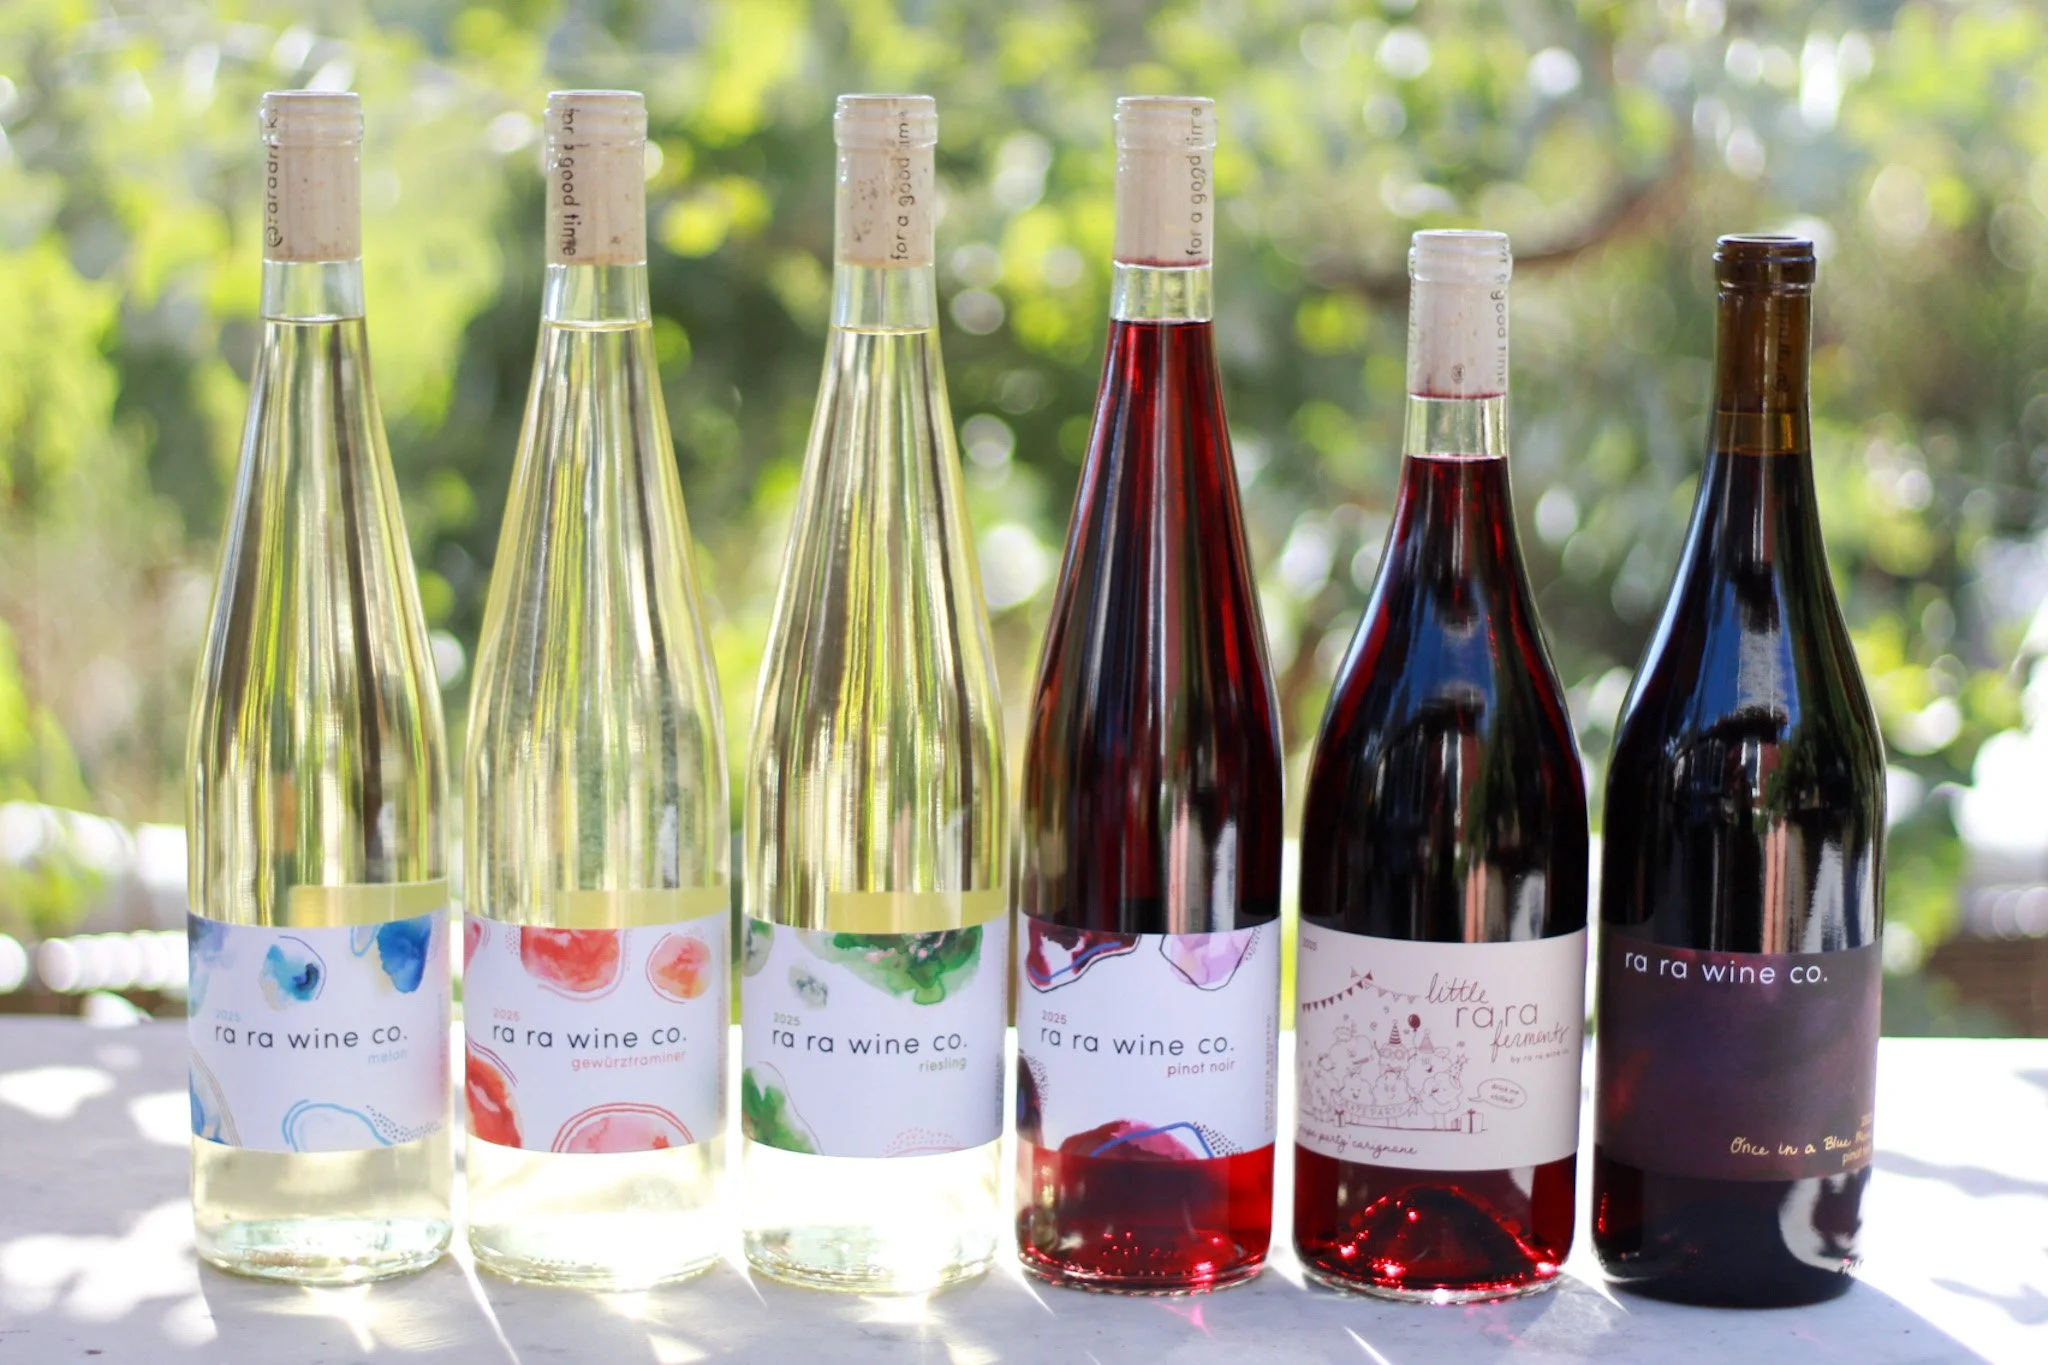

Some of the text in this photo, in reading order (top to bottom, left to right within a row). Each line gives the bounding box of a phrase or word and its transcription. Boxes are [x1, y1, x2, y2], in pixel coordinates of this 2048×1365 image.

[559, 157, 581, 206] good
[891, 157, 915, 207] good
[1186, 155, 1207, 205] good
[898, 215, 909, 227] a
[1191, 212, 1202, 223] a
[562, 213, 581, 256] time
[1185, 232, 1202, 256] for
[891, 234, 909, 260] for
[1625, 952, 1828, 984] ra ra wine co.
[1425, 973, 1489, 1004] little
[215, 1009, 241, 1022] 2025
[493, 1007, 521, 1021] 2025
[773, 1012, 801, 1026] 2025
[1041, 1010, 1067, 1025] 2025
[215, 1025, 408, 1049] ra ra wine co.
[493, 1025, 687, 1049] ra ra wine co.
[772, 1029, 967, 1054] ra ra wine co.
[1041, 1027, 1234, 1056] ra ra wine co.
[1489, 1020, 1569, 1064] ferments
[368, 1049, 407, 1064] melon
[571, 1050, 686, 1071] gewürztraminer
[919, 1057, 967, 1073] riesling
[1167, 1059, 1235, 1077] pinot noir
[1352, 1140, 1418, 1159] carignane
[1730, 1137, 1769, 1155] Once
[1779, 1142, 1799, 1155] in
[1804, 1144, 1816, 1154] a
[1823, 1136, 1852, 1150] Blue
